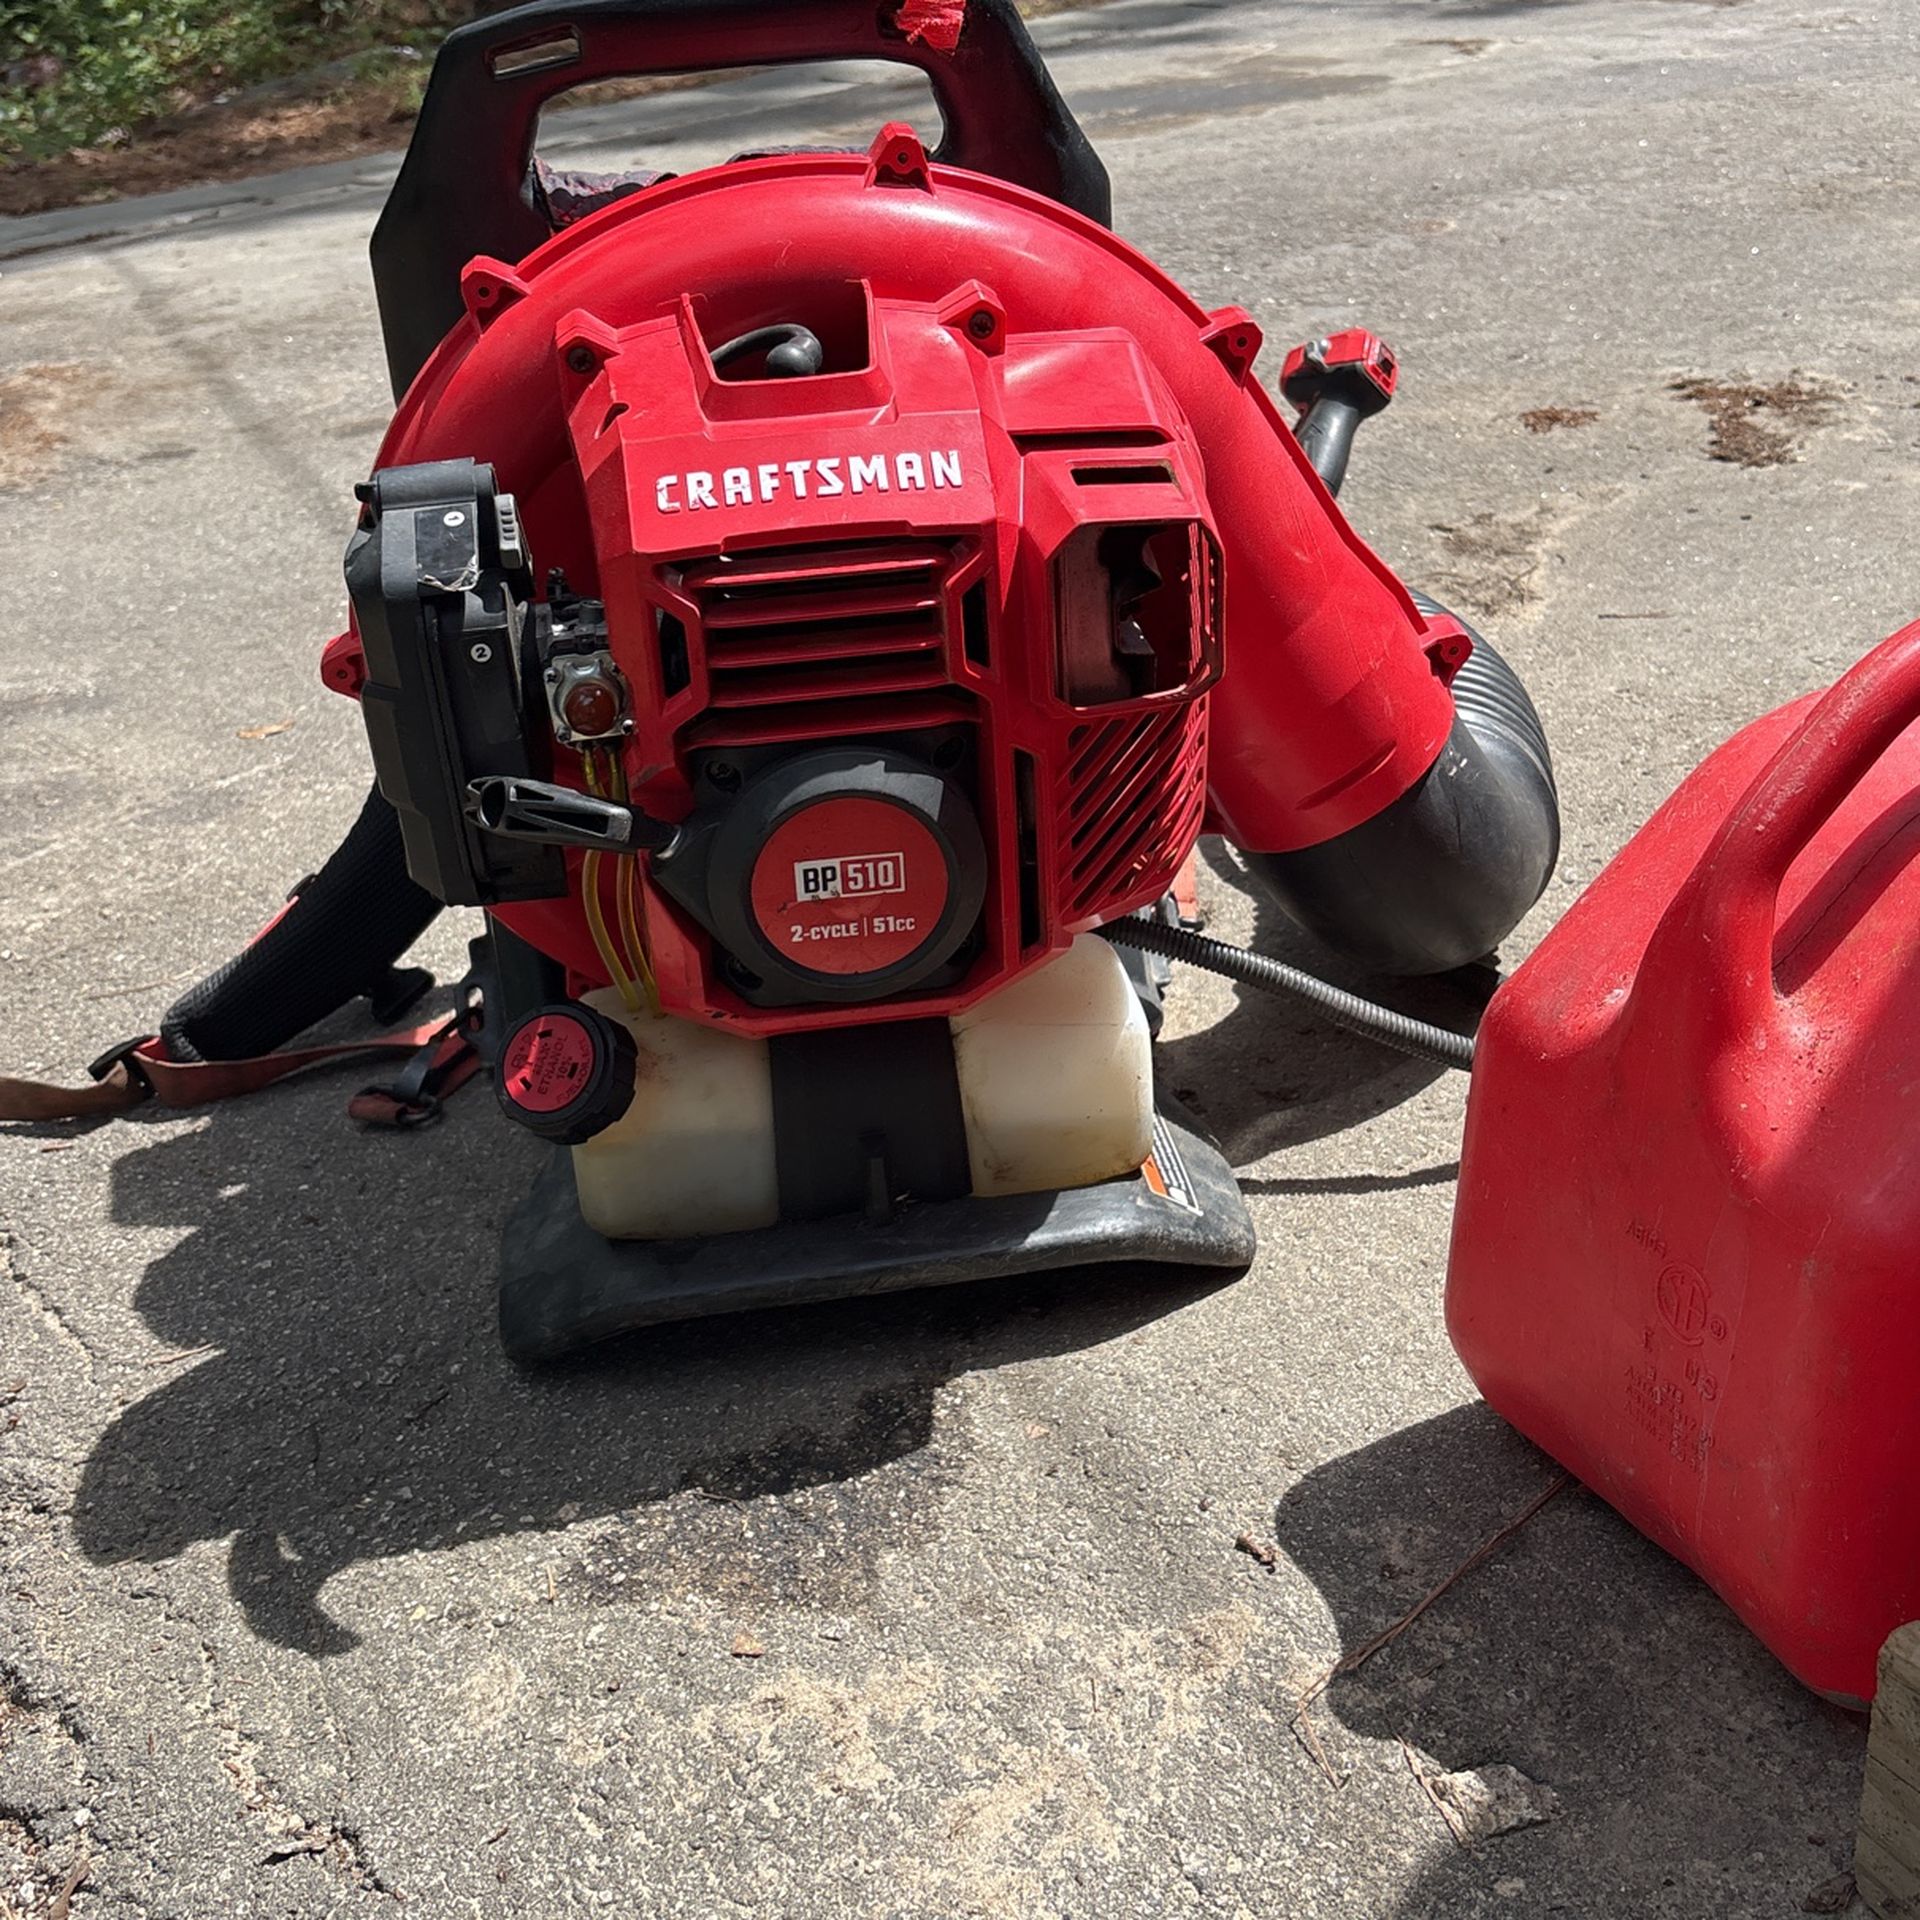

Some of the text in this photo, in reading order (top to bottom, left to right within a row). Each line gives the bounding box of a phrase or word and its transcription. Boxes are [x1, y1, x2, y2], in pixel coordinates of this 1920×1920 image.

[656, 450, 963, 514] CRAFTSMAN
[475, 646, 488, 660] 2
[802, 860, 895, 894] BP 510
[790, 922, 860, 943] 2-CYCLE
[537, 1035, 569, 1095] ETHANOL
